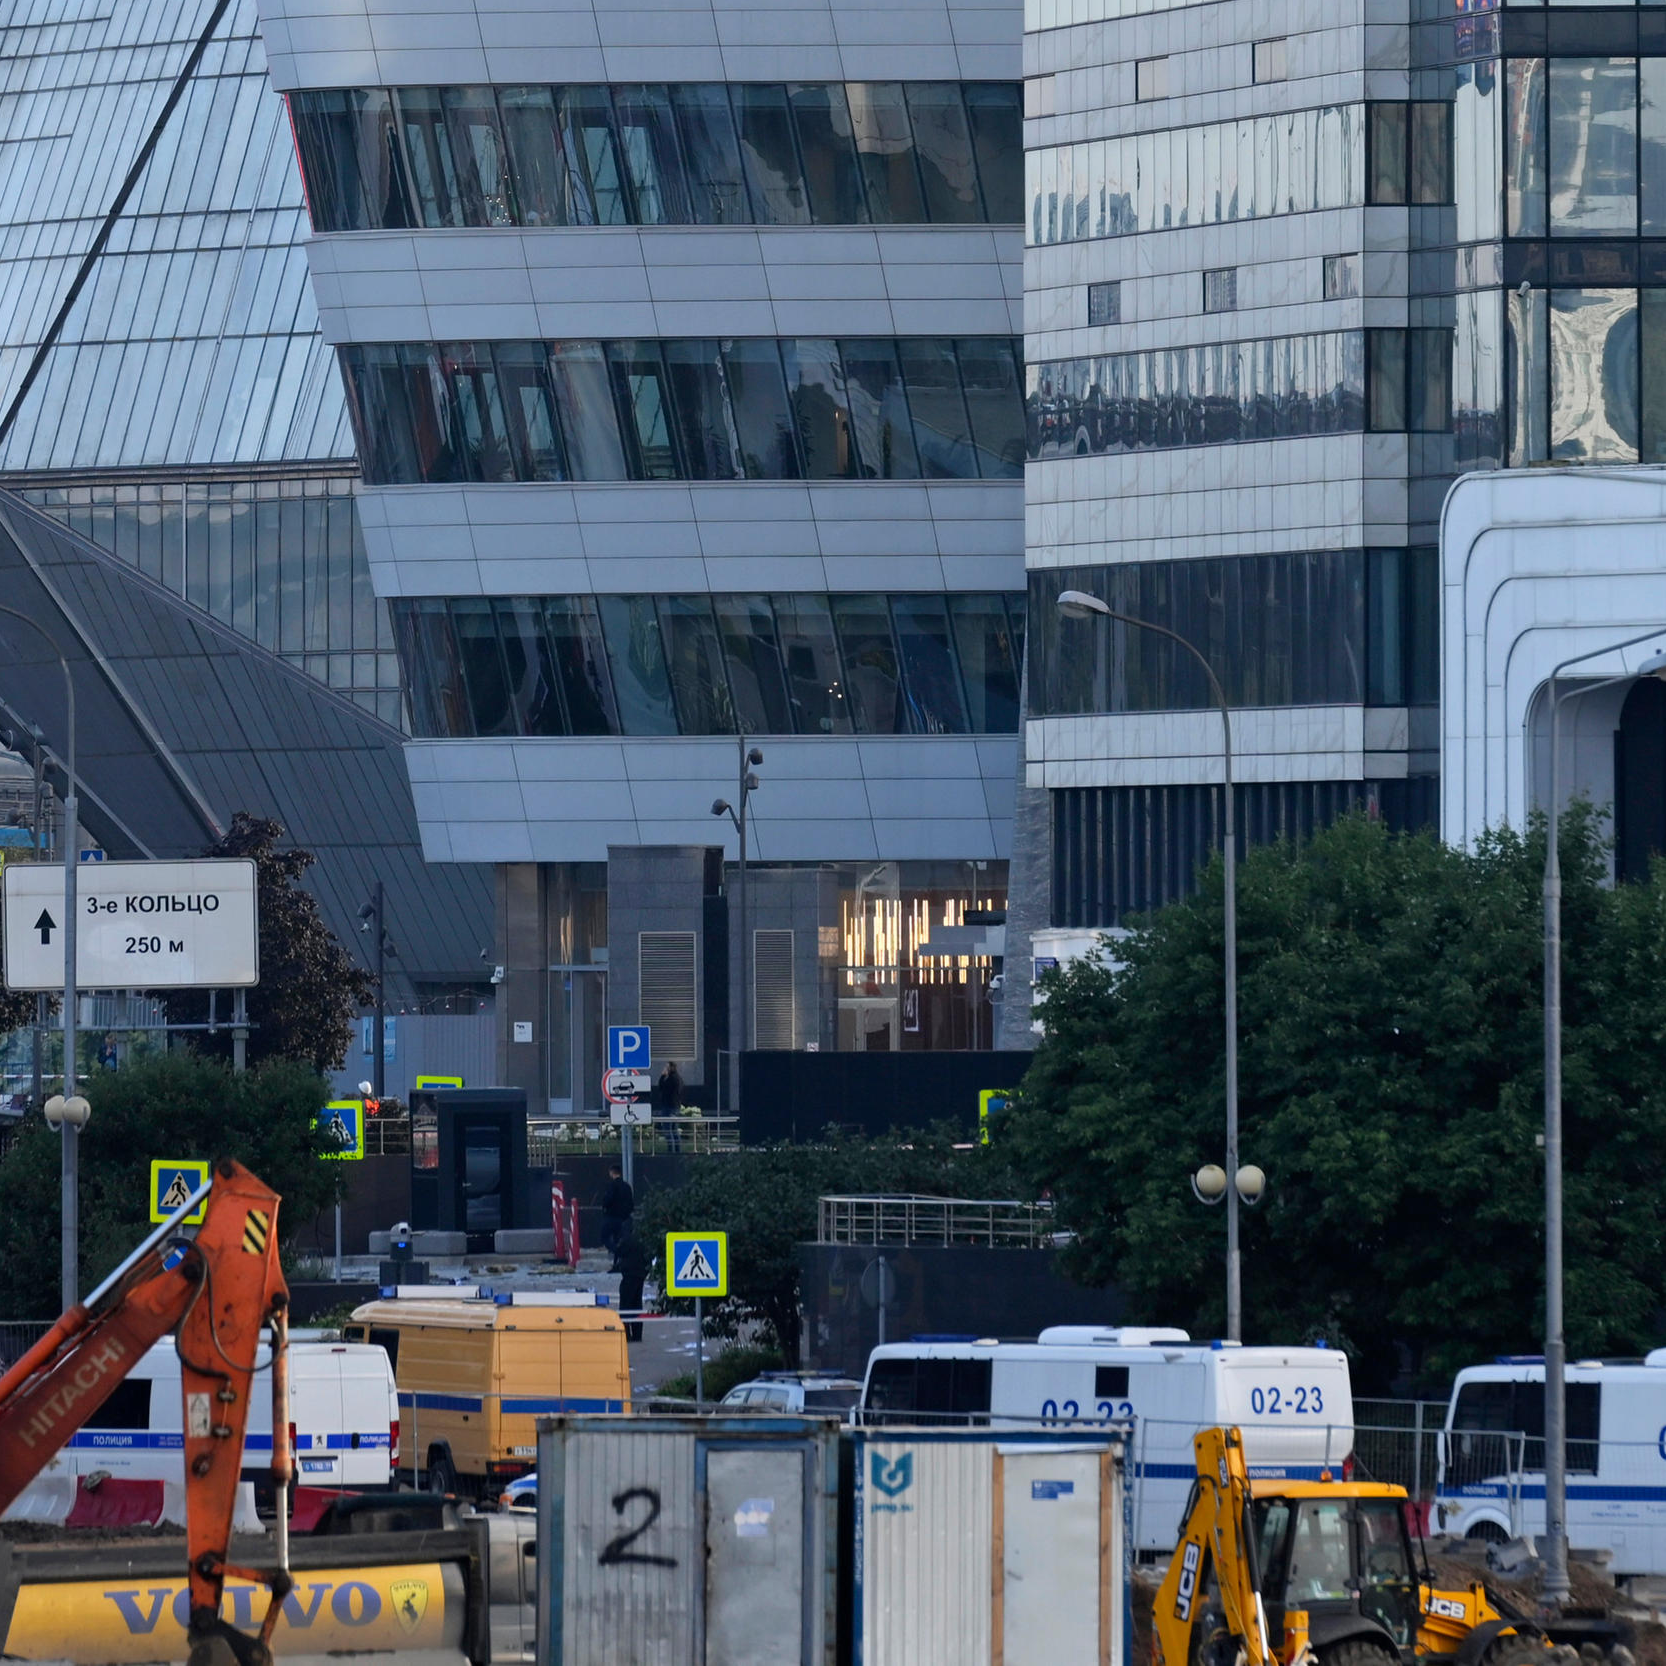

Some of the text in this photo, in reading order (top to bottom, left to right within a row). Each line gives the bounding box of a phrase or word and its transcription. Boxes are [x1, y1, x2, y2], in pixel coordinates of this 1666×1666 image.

[87, 894, 220, 915] 3-е КОЛЬЦО
[125, 936, 184, 953] 250 м
[618, 1030, 642, 1065] P
[18, 1337, 126, 1448] HITACHI
[1251, 1386, 1324, 1415] 02-23
[93, 1436, 133, 1446] ПОЛИЦИЯ
[598, 1487, 678, 1567] 2
[1176, 1542, 1200, 1622] JCB
[1425, 1597, 1466, 1619] JCB
